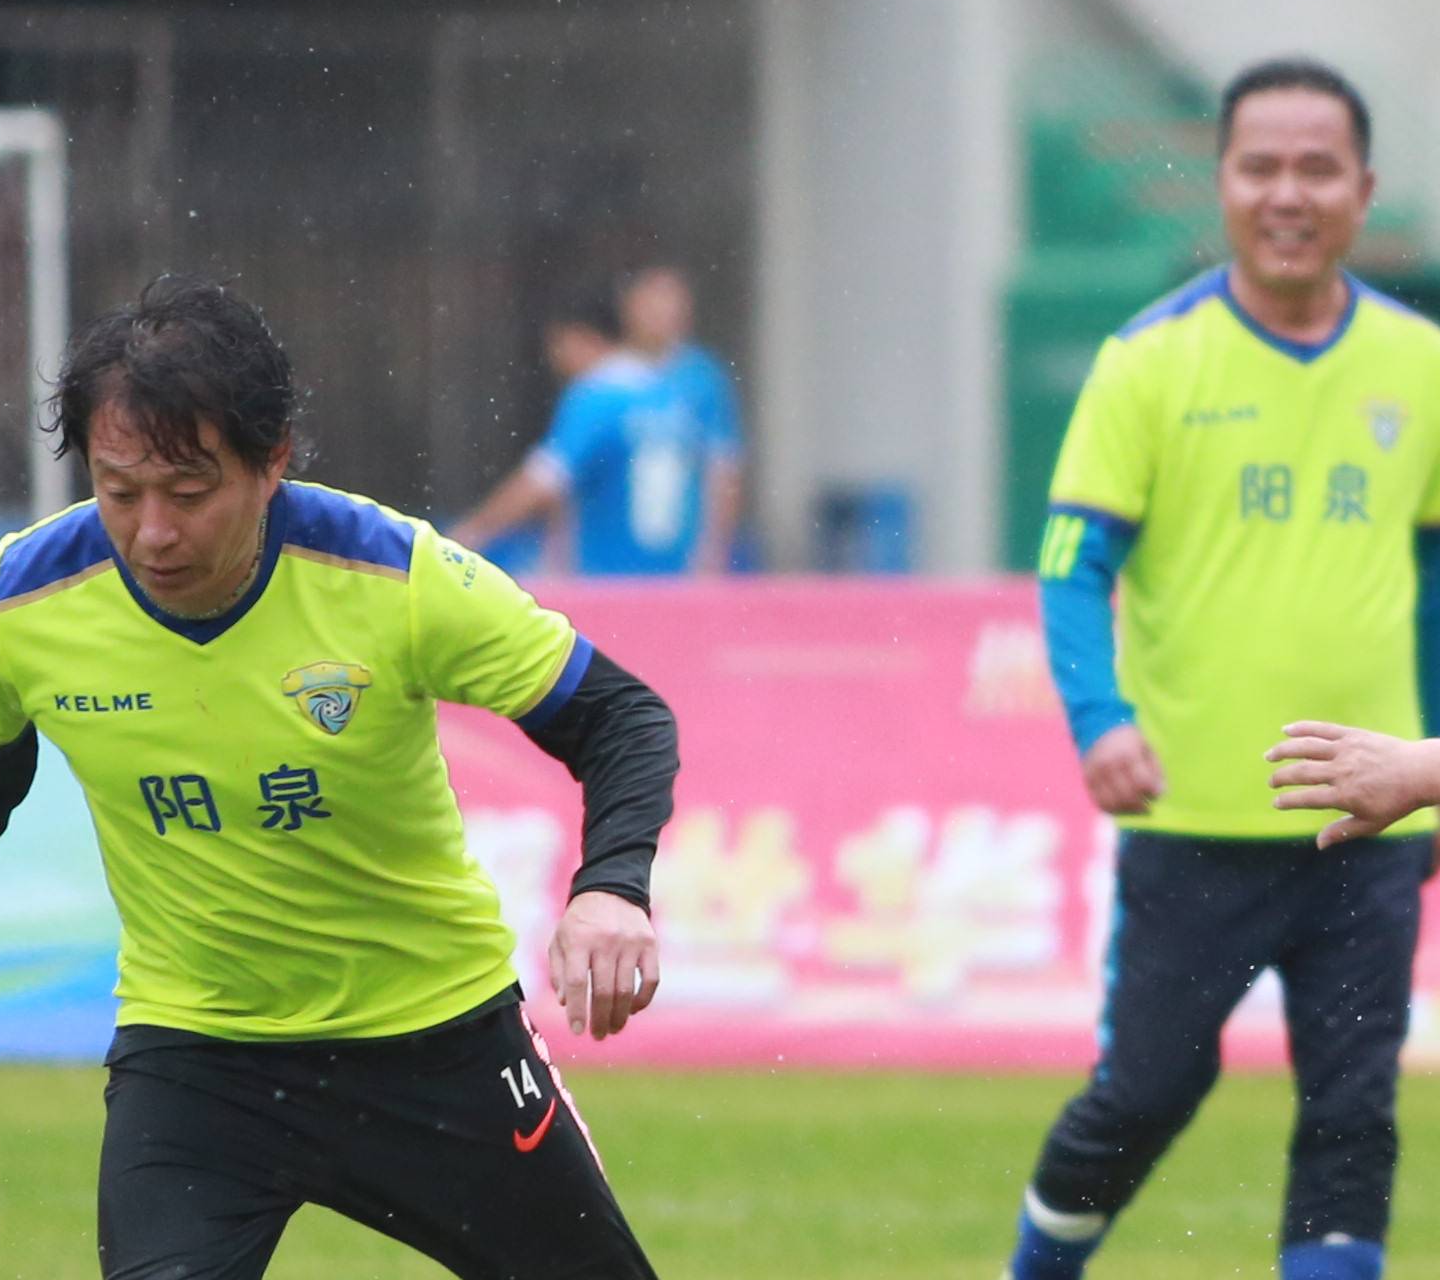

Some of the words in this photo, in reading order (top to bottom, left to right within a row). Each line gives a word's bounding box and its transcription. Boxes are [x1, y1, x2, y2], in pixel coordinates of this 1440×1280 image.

[1240, 463, 1372, 524] 阳泉
[54, 692, 153, 713] KELME
[139, 763, 333, 836] 阳泉
[500, 1059, 543, 1109] 14
